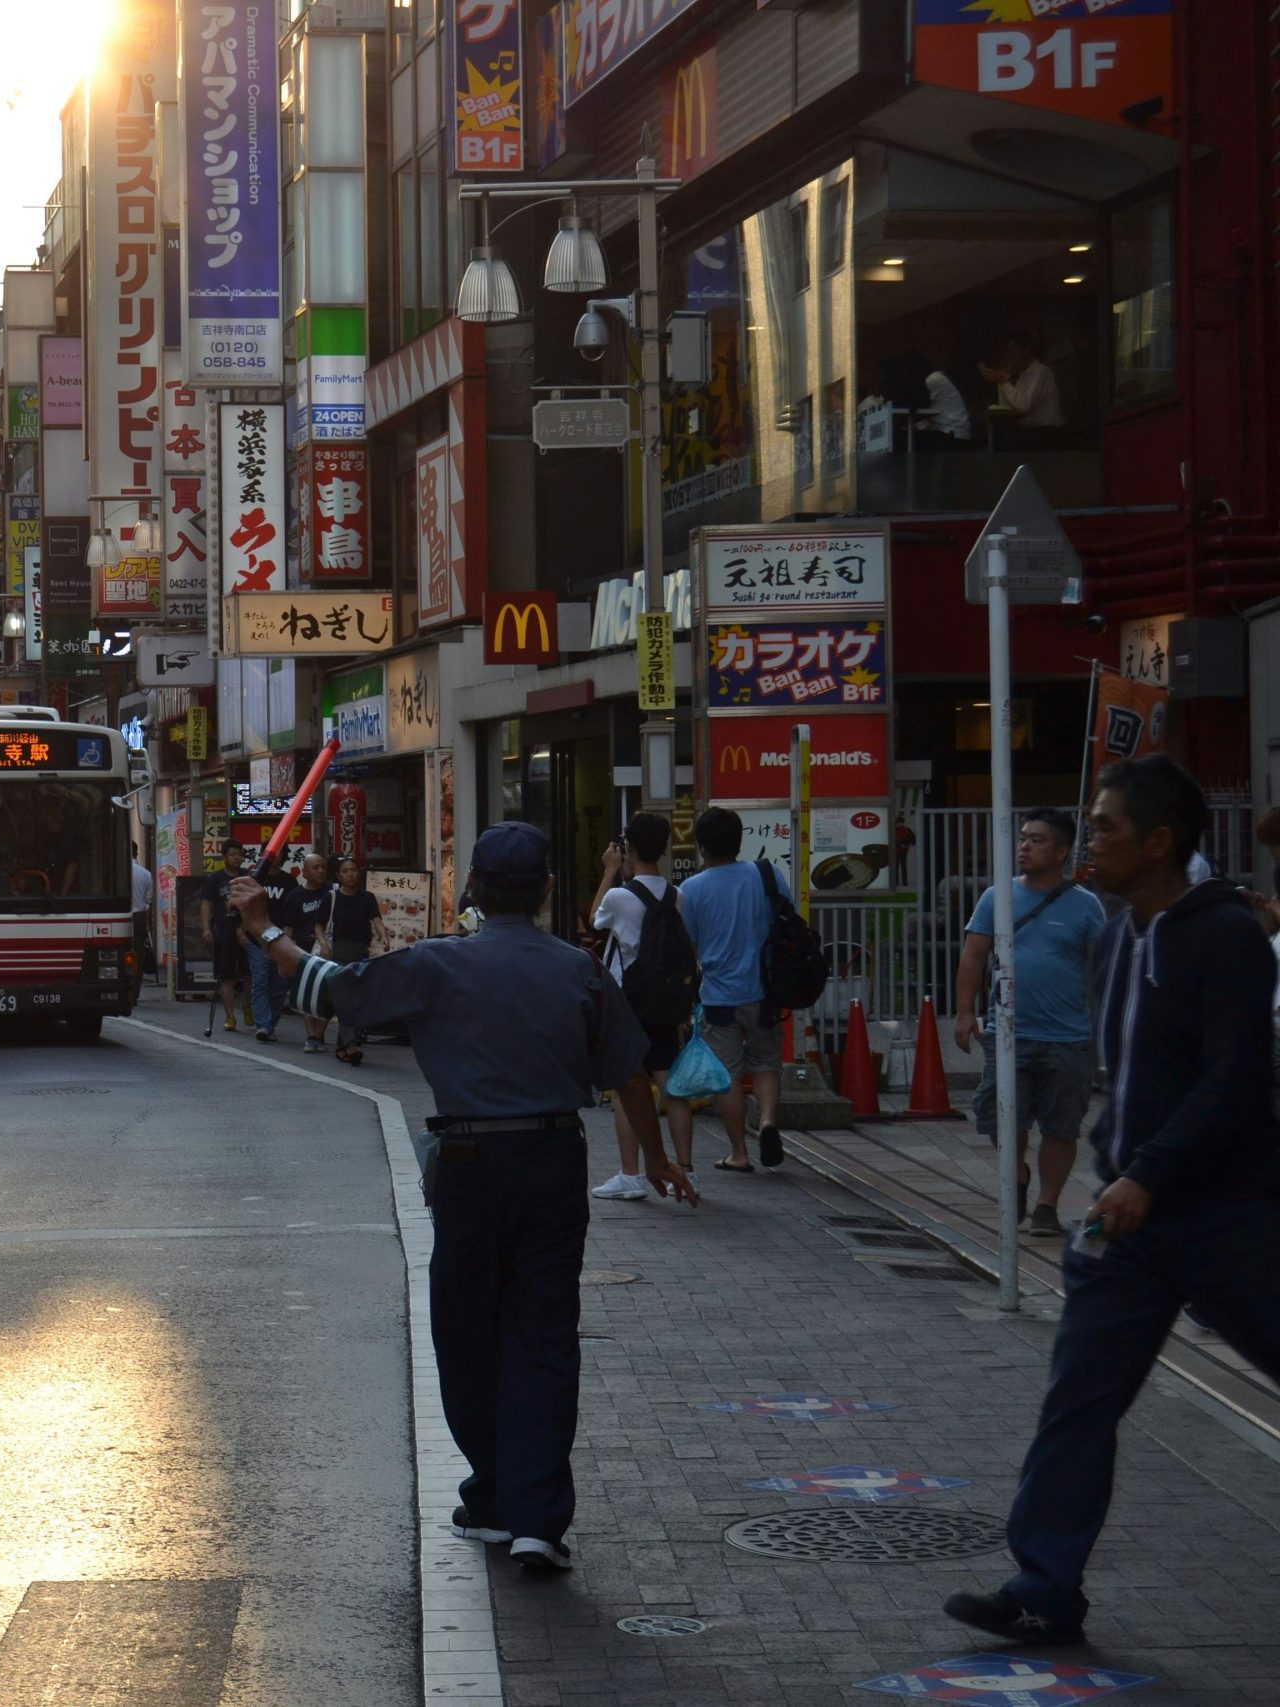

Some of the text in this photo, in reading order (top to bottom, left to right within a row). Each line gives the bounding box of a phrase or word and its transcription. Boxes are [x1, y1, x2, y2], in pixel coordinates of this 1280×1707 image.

[977, 29, 1116, 92] B1F
[246, 7, 261, 205] Dramatic Communication
[462, 92, 500, 115] Ban
[476, 103, 515, 127] Ban
[200, 5, 243, 269] アパマンショップ
[461, 136, 518, 163] B1F
[202, 325, 267, 336] 吉祥寺南口店
[210, 341, 259, 353] (0120)
[203, 356, 266, 368] 058-845
[314, 374, 362, 384] FamilyMart
[560, 409, 604, 422] 吉祥寺
[331, 426, 364, 437] たばこ
[235, 408, 267, 504] 横浜家系
[317, 477, 364, 570] 串鳥
[723, 555, 866, 588] 元祖寿司
[104, 580, 148, 601] 聖地
[732, 592, 755, 602] Sushi
[805, 590, 858, 600] restaurant
[243, 611, 267, 620] 牛たん
[279, 603, 388, 646] ねぎし
[646, 616, 665, 706] 防犯カメラ作動中
[717, 629, 877, 671] カラオケ
[758, 669, 801, 695] Ban
[791, 675, 834, 701] Ban
[843, 683, 881, 700] B1F
[400, 673, 435, 735] ねぎし
[340, 710, 381, 742] FamilyMart
[856, 815, 876, 827] 1F
[261, 826, 302, 843] BF
[383, 876, 418, 890] ねぎし
